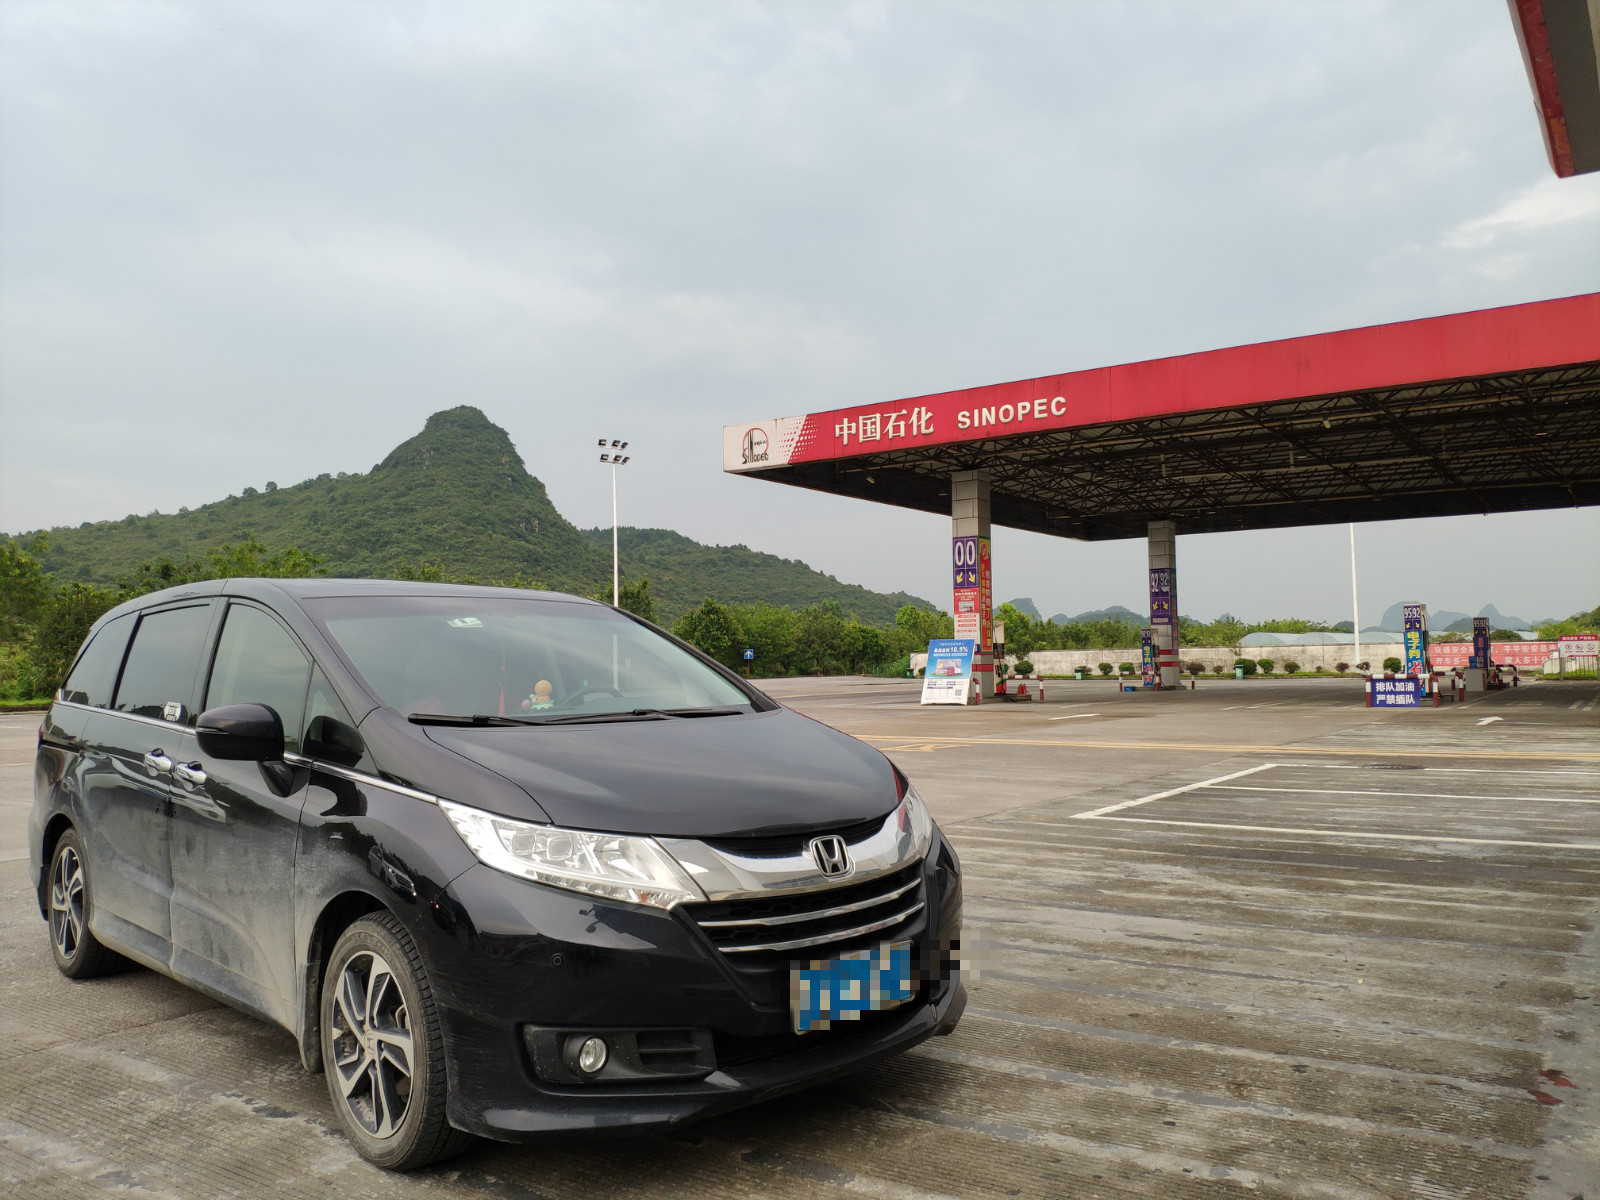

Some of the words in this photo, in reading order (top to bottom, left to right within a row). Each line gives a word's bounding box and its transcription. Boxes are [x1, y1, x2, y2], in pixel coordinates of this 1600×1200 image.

[835, 406, 934, 446] 中国石化
[957, 396, 1067, 430] SINOPEC
[1404, 608, 1412, 619] 95
[1412, 607, 1420, 619] 92
[1375, 681, 1415, 692] 排队加油
[1376, 694, 1416, 705] 严禁插队
